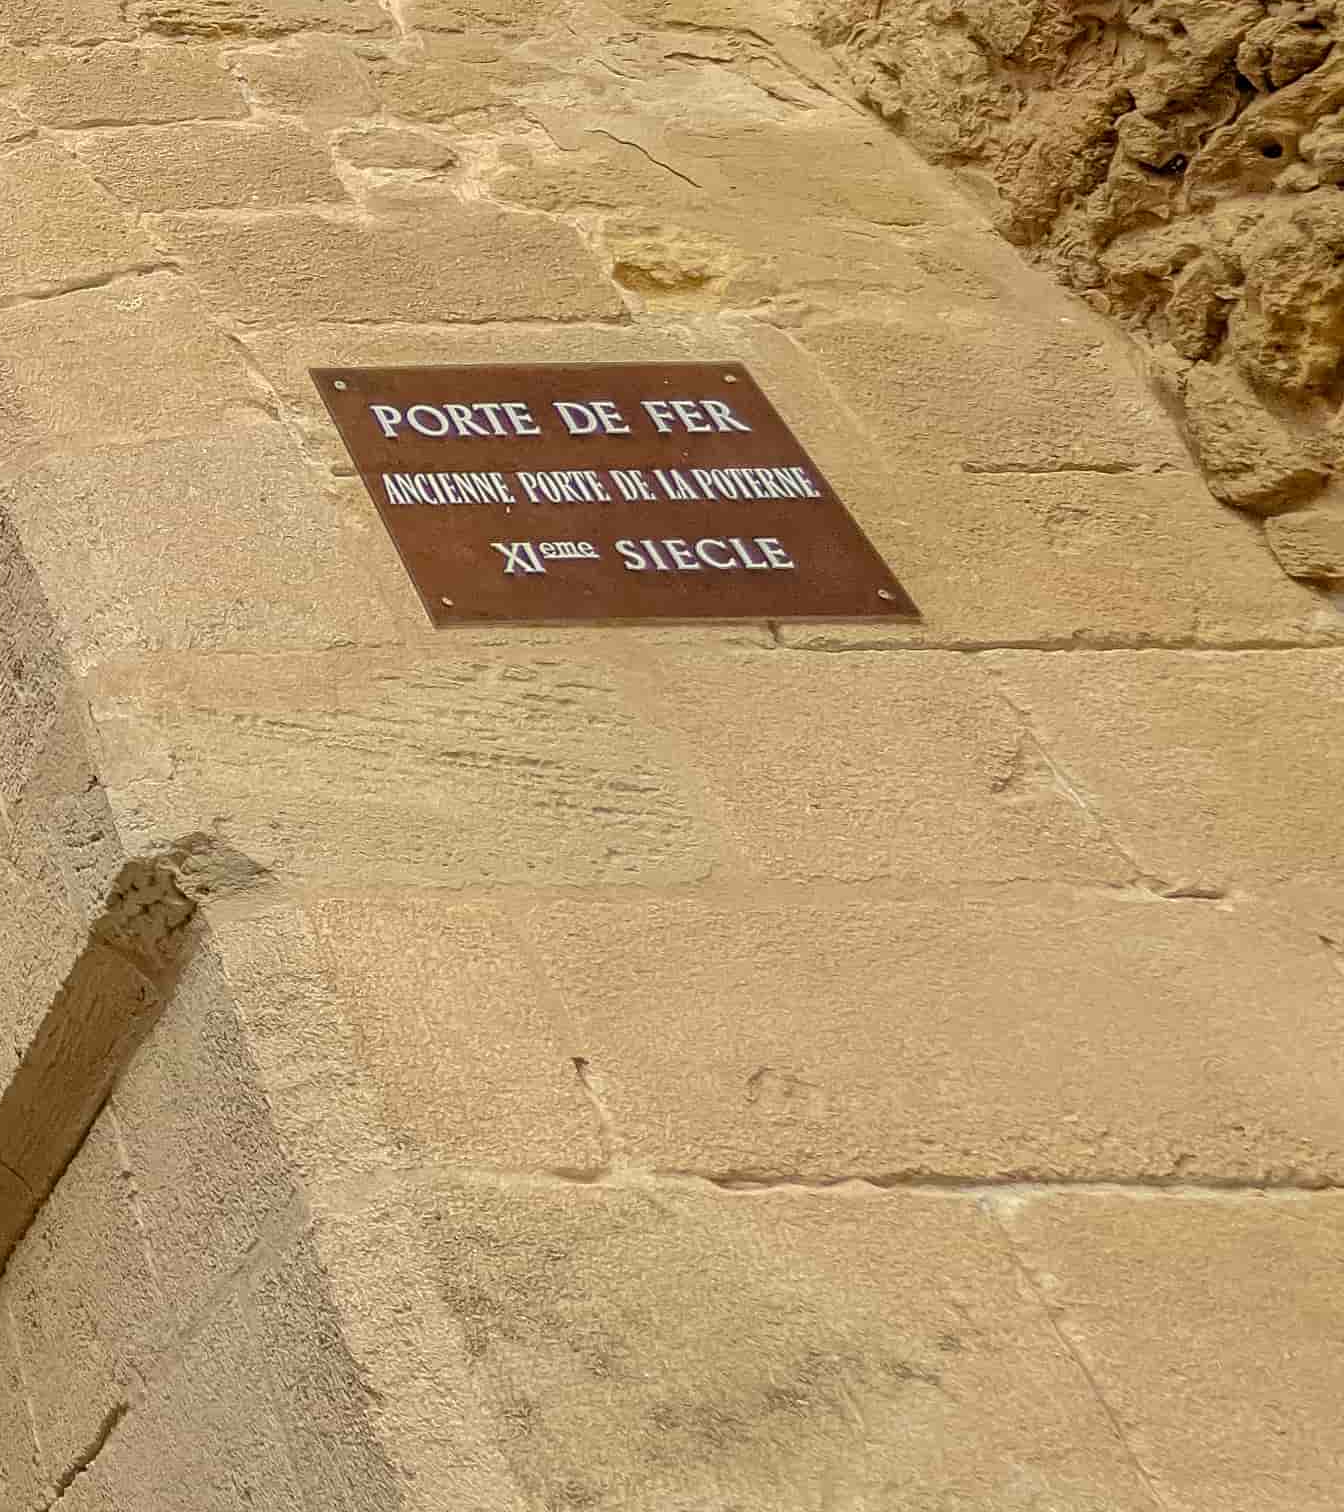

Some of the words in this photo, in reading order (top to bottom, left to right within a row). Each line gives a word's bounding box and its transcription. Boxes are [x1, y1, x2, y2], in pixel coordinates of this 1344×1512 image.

[369, 401, 541, 438] PORTE
[552, 400, 630, 435] DE
[641, 399, 752, 433] FER
[381, 472, 515, 505] ANCIENNE
[518, 470, 610, 504] PORTE
[609, 469, 657, 502] DE
[653, 469, 699, 500] LA
[689, 467, 820, 499] POTERNE
[490, 539, 600, 574] XIeme
[615, 538, 795, 571] SIECLE
